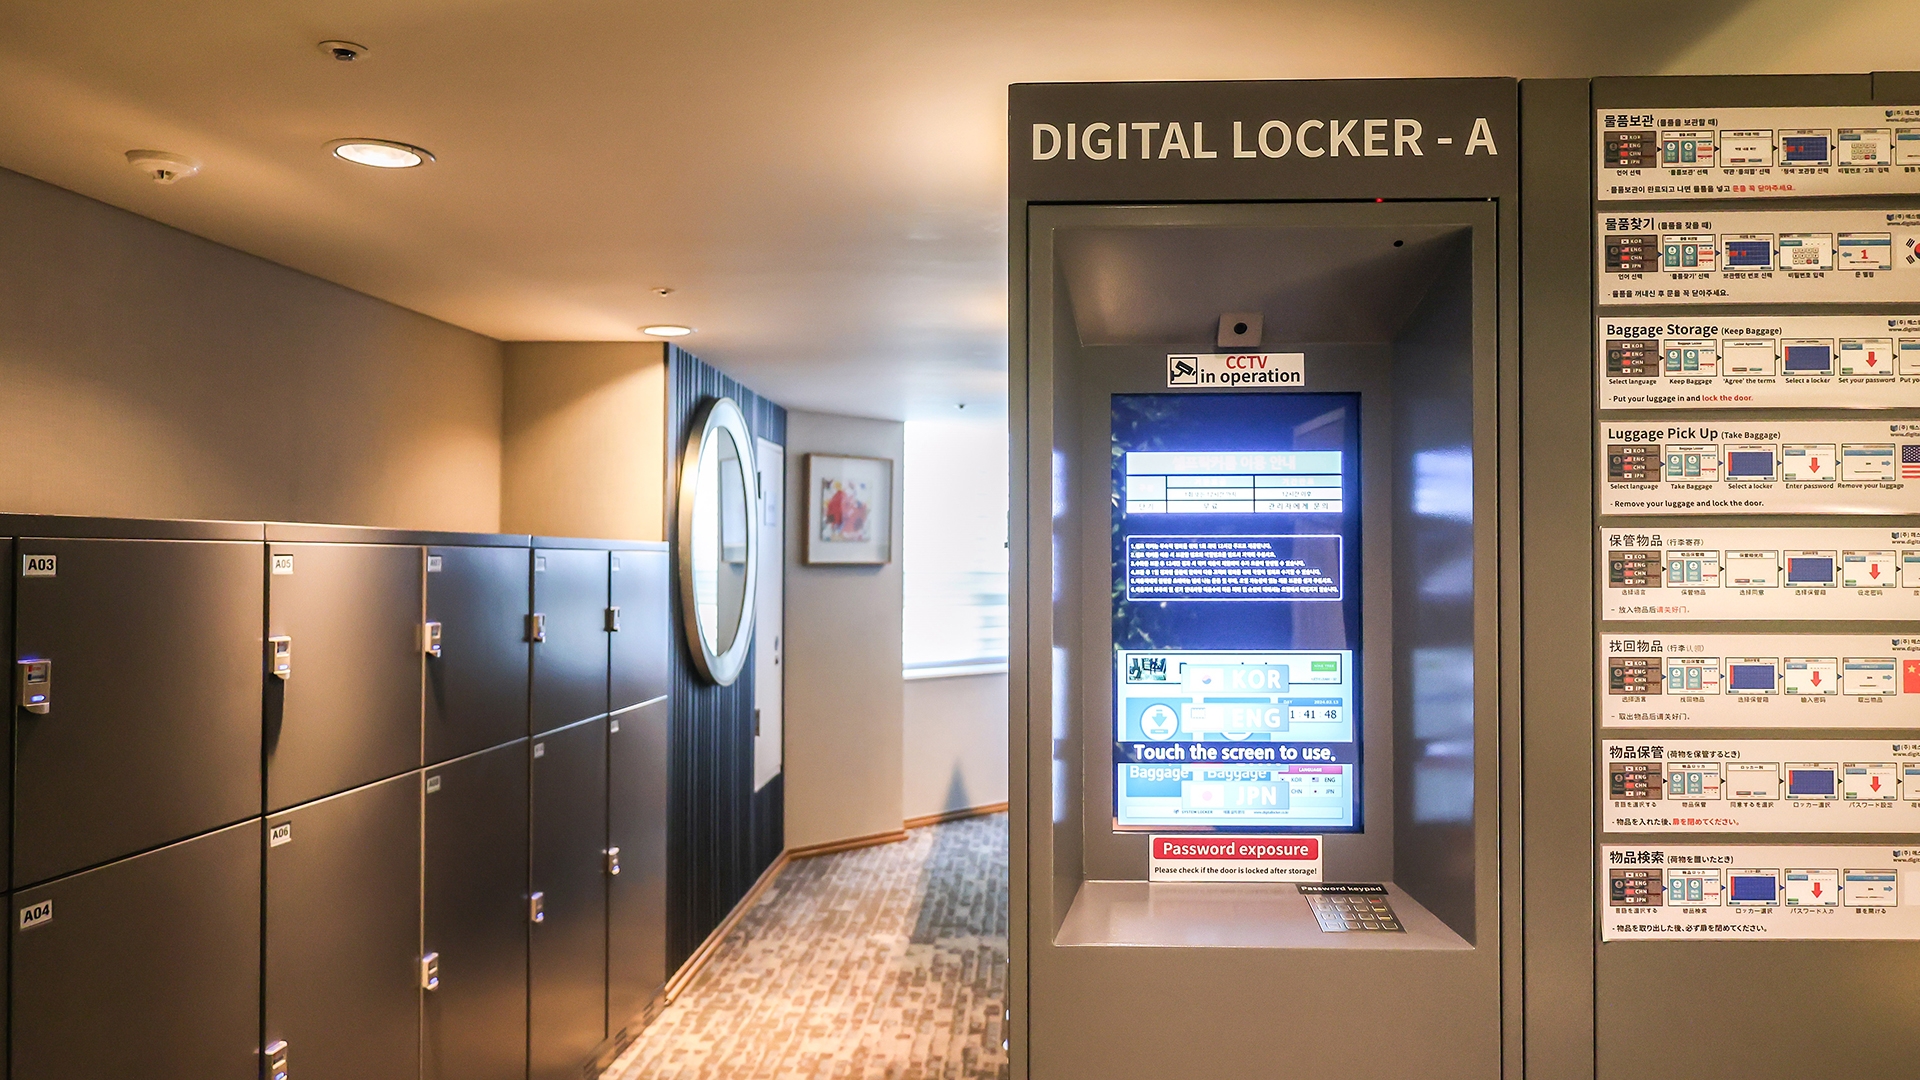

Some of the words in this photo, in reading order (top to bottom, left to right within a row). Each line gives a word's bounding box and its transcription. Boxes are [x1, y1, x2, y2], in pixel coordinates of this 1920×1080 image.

[1604, 114, 1654, 127] 물품보관
[1032, 121, 1217, 160] DIGITAL
[1233, 119, 1423, 159] LOCKER
[1465, 118, 1498, 156] A
[1605, 217, 1654, 230] 물품찾기
[1860, 250, 1868, 259] 1
[1607, 324, 1664, 338] Baggage
[1667, 324, 1718, 337] Storage
[1722, 327, 1744, 335] (Keep
[1746, 327, 1782, 335] Baggage)
[1226, 355, 1267, 370] CCTV
[1200, 368, 1216, 383] in
[1220, 368, 1301, 386] operation
[1608, 428, 1664, 442] Luggage
[1668, 427, 1695, 439] Pick
[1700, 428, 1718, 441] Up
[1721, 432, 1742, 440] (Take
[1745, 432, 1780, 440] Baggage)
[1609, 534, 1663, 547] 保管物品
[28, 559, 54, 571] A03
[275, 559, 291, 568] A05
[1609, 639, 1663, 652] 找回物品
[1232, 669, 1281, 689] KOR
[1232, 708, 1281, 728] ENG
[1134, 744, 1184, 760] Touch
[1190, 744, 1217, 760] the
[1221, 747, 1275, 760] screen
[1280, 745, 1298, 760] to
[1303, 747, 1336, 761] use.
[1610, 746, 1664, 759] 物品保管
[1667, 750, 1740, 758] (荷物を保管するとき)
[1130, 765, 1189, 781] Baggage
[1236, 786, 1277, 806] JPN
[272, 828, 288, 839] A06
[1163, 842, 1235, 856] Password
[1239, 844, 1308, 858] exposure
[1610, 851, 1664, 864] 物品検索
[1289, 867, 1317, 876] storage!
[24, 904, 50, 924] A04
